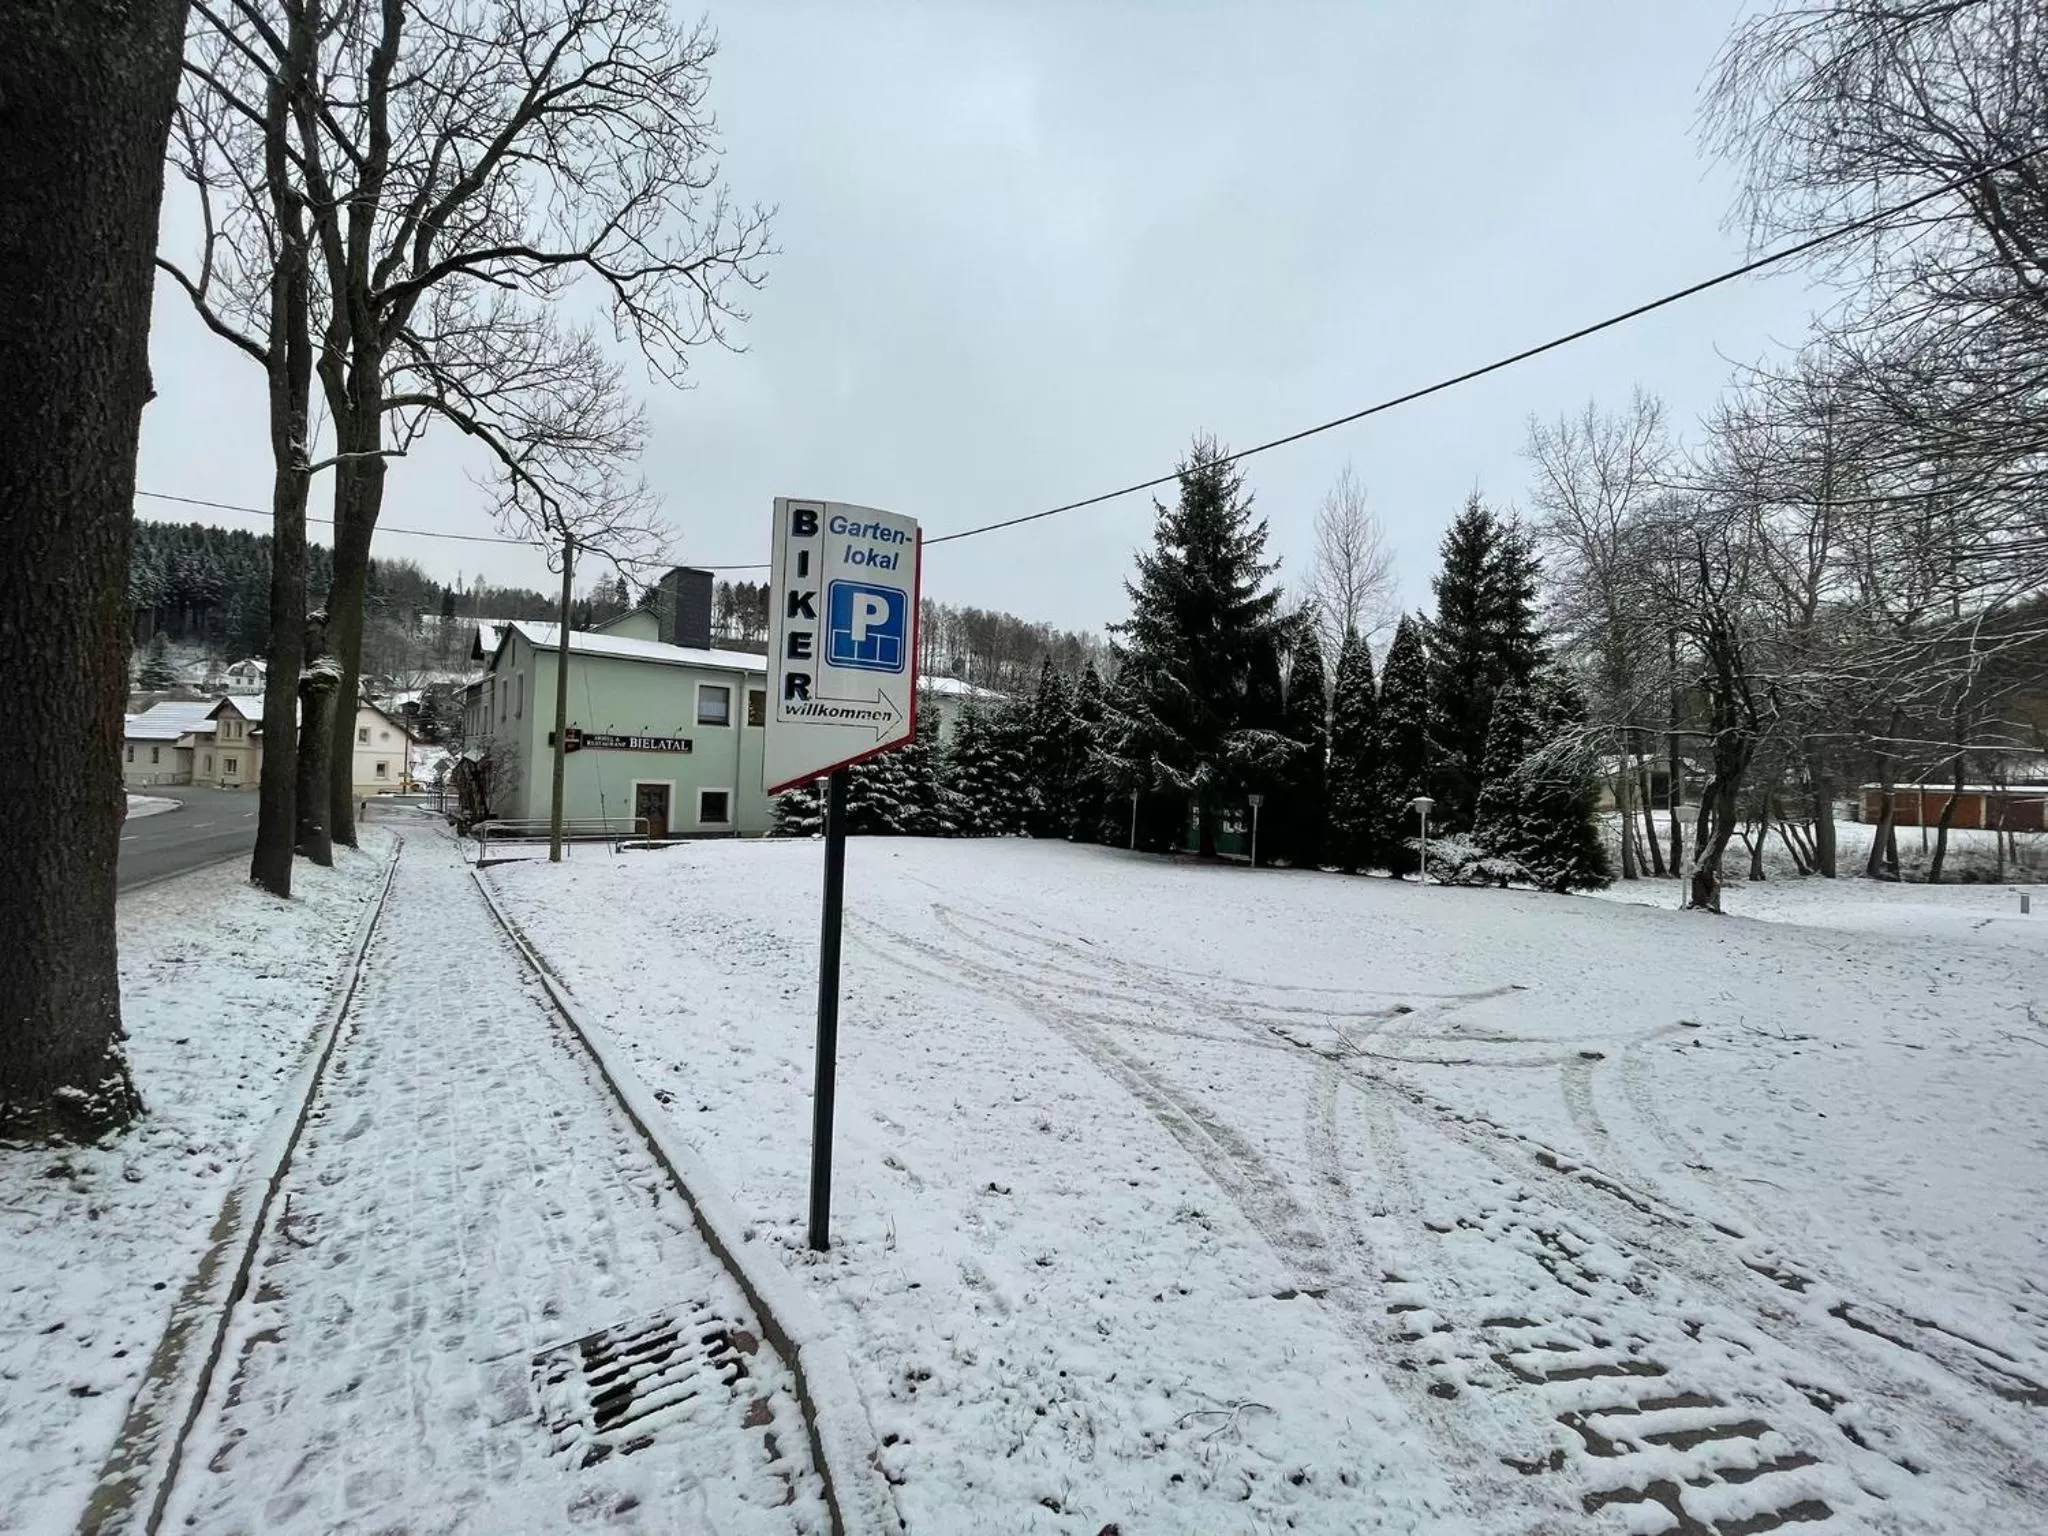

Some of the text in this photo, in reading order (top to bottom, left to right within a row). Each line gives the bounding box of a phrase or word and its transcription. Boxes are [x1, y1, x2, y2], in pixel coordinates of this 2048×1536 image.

[829, 515, 913, 545] Garten-
[843, 544, 899, 571] lokal
[784, 508, 819, 701] BIKER
[851, 592, 890, 641] P
[785, 702, 892, 721] willkommen
[630, 737, 688, 750] BIELATAL
